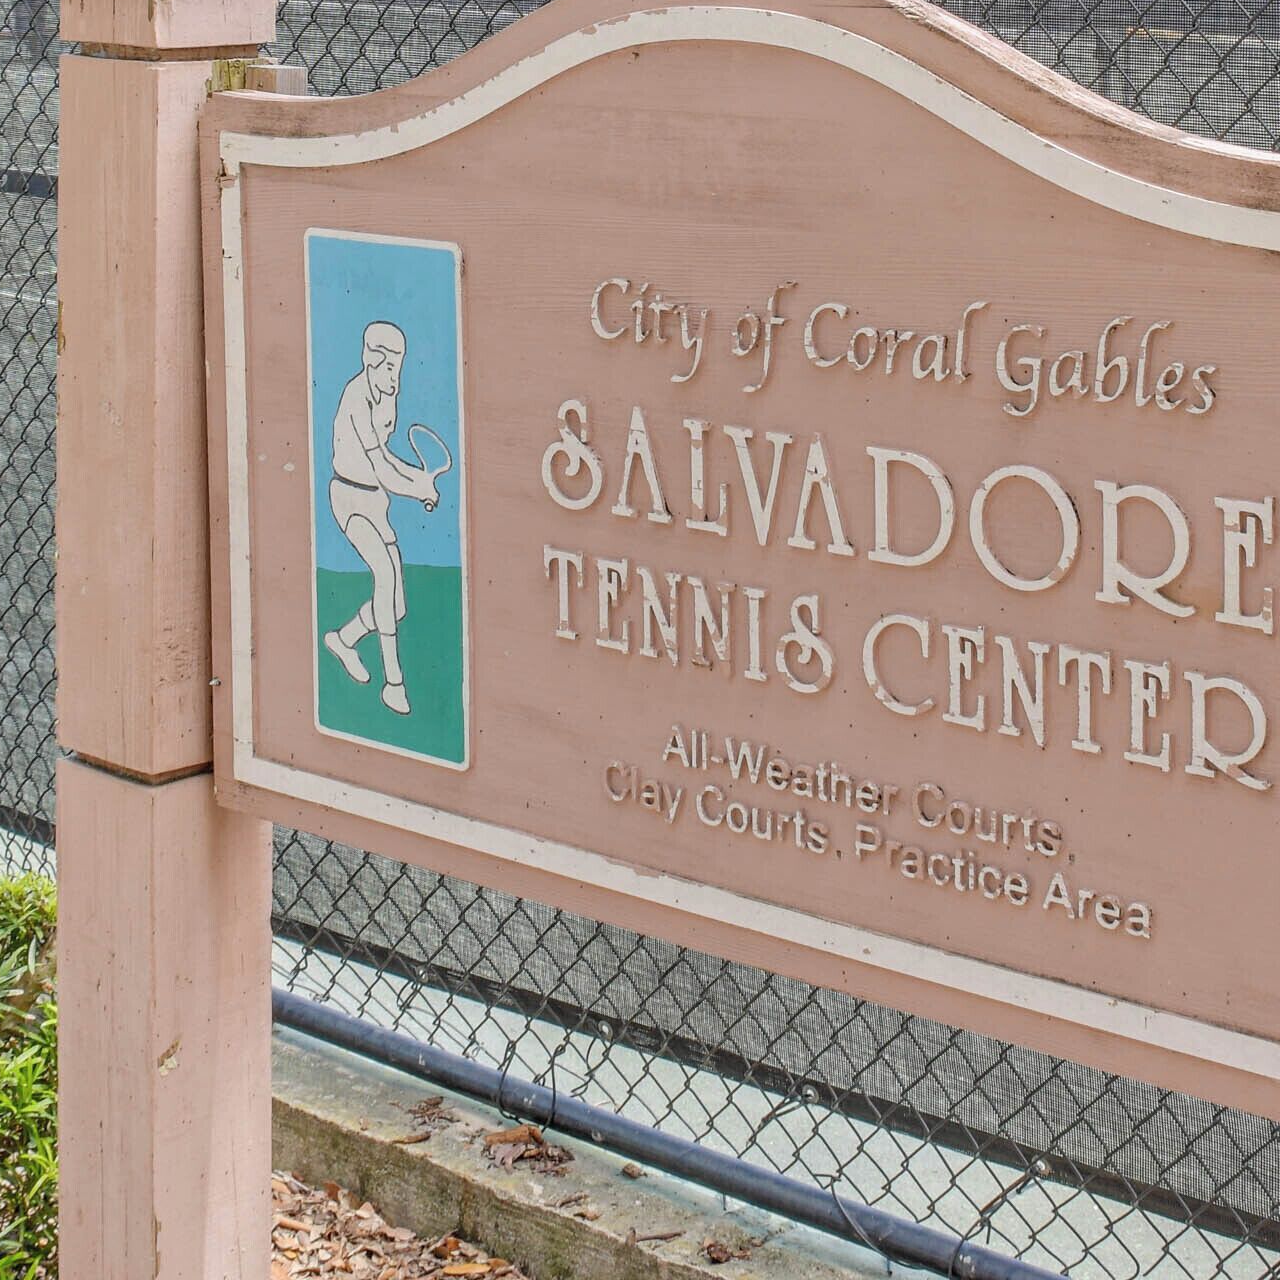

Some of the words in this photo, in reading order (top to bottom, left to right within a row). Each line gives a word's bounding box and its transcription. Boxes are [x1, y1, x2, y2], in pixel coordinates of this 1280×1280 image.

[590, 278, 710, 383] City
[732, 280, 799, 393] of
[803, 301, 991, 384] Coral
[996, 315, 1220, 417] Gables
[541, 399, 1276, 636] SALVADORE
[543, 543, 836, 696] TENNIS
[862, 613, 1272, 791] CENTER
[602, 759, 685, 824] Clay
[854, 822, 1030, 906] Practice
[1042, 870, 1154, 939] Area
[661, 724, 899, 817] All-Weather
